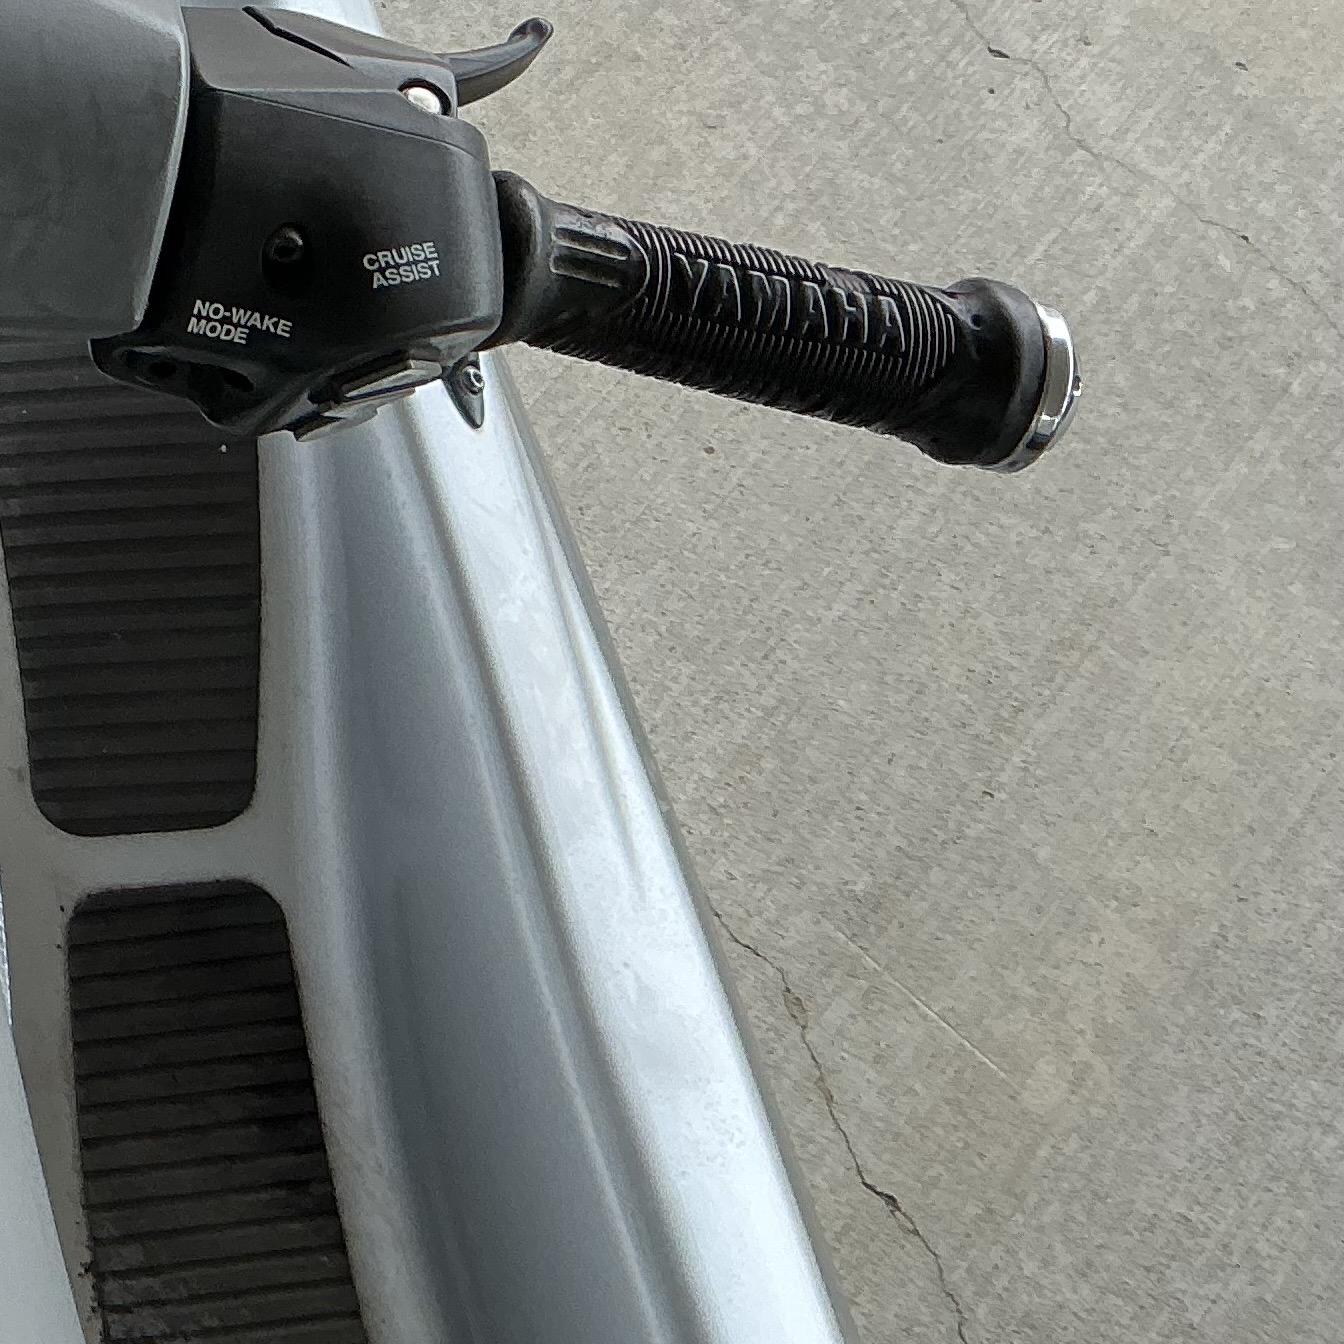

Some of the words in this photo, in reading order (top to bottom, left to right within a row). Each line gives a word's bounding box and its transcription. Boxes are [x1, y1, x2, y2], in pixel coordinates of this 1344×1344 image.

[362, 241, 438, 271] CRUISE
[372, 260, 440, 289] ASSIST
[187, 317, 250, 345] MODE
[193, 299, 293, 338] NO-WAKE
